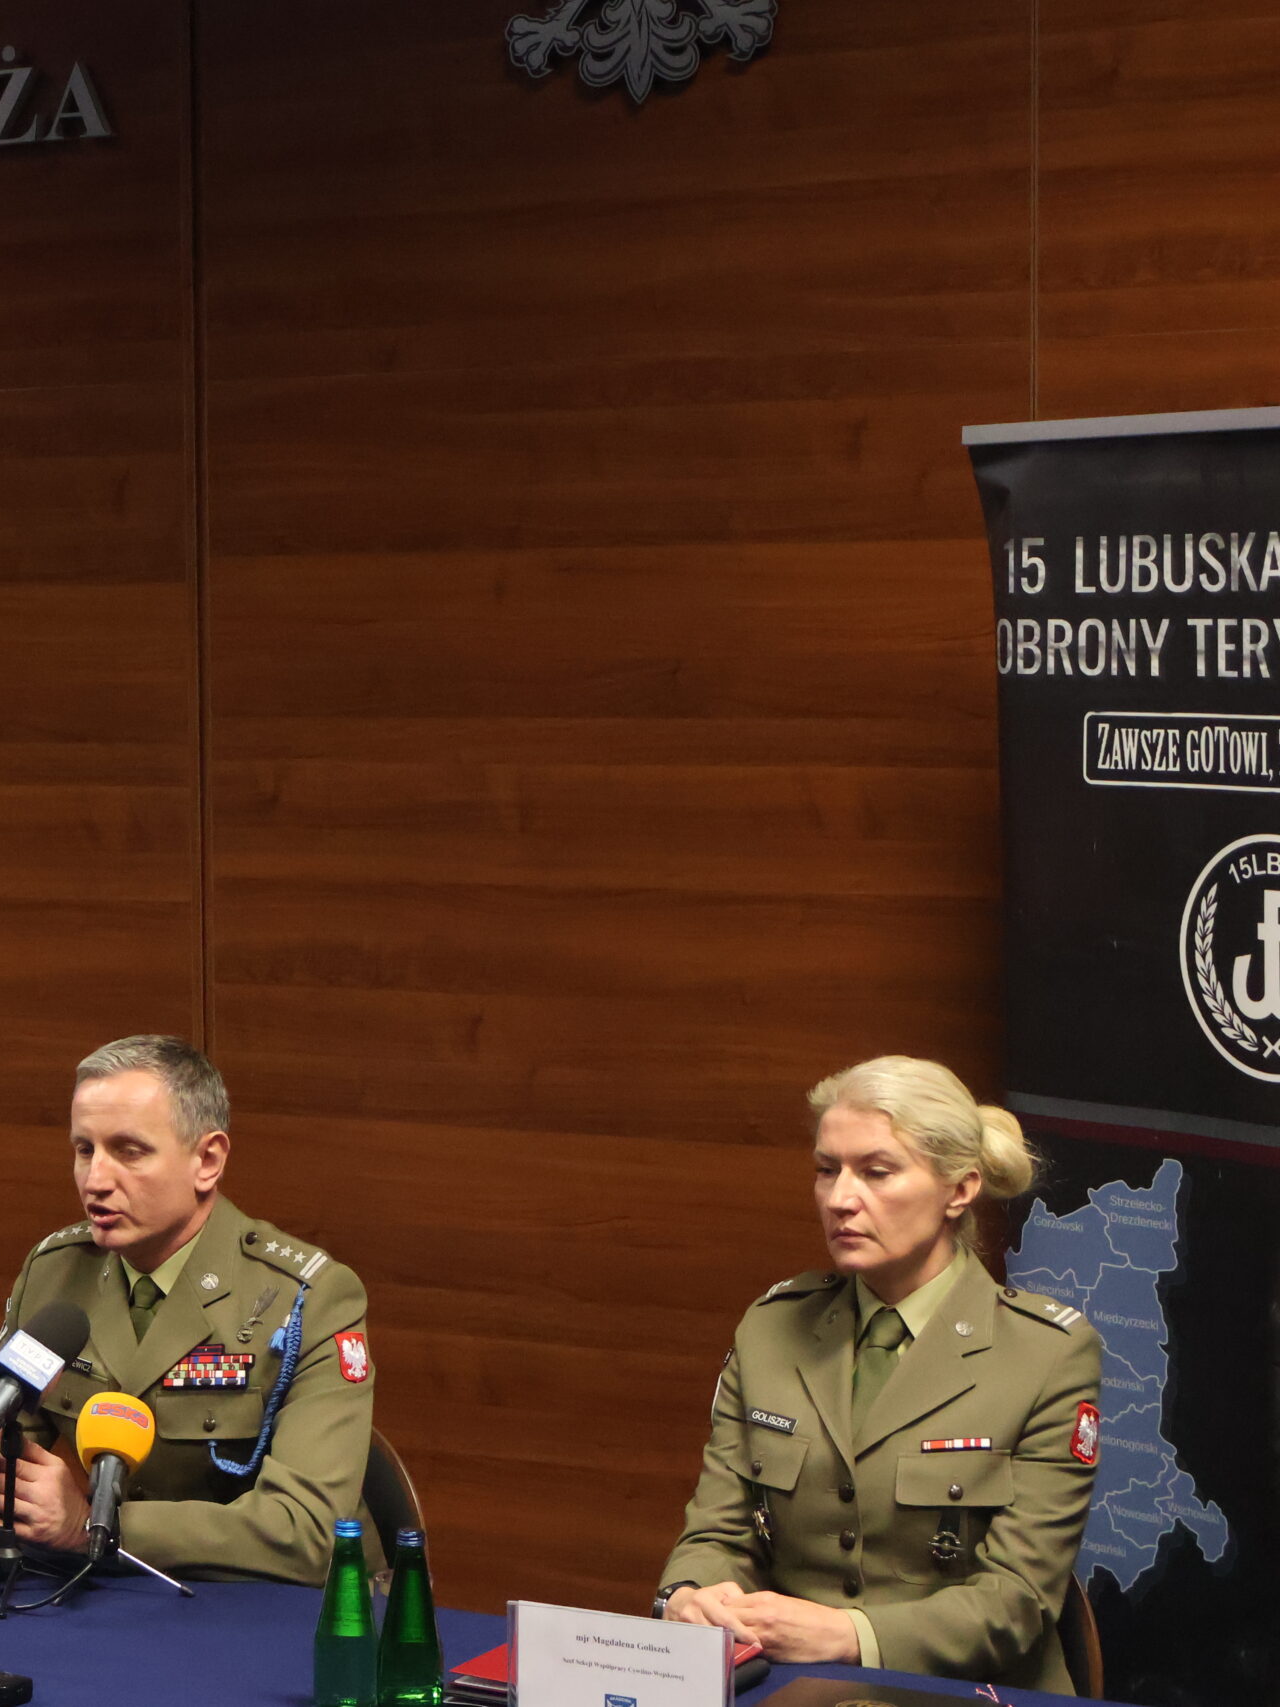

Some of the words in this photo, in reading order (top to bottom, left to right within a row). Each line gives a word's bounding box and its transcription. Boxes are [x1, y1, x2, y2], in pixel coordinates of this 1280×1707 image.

[1003, 537, 1046, 595] 15
[1074, 531, 1280, 594] LUBUSKA
[997, 618, 1170, 676] OBRONY
[1097, 723, 1181, 772] ZAWSZE
[1186, 726, 1274, 782] GOTOWI,
[751, 1410, 792, 1429] GOLISZEK
[592, 1635, 635, 1649] Magdalena
